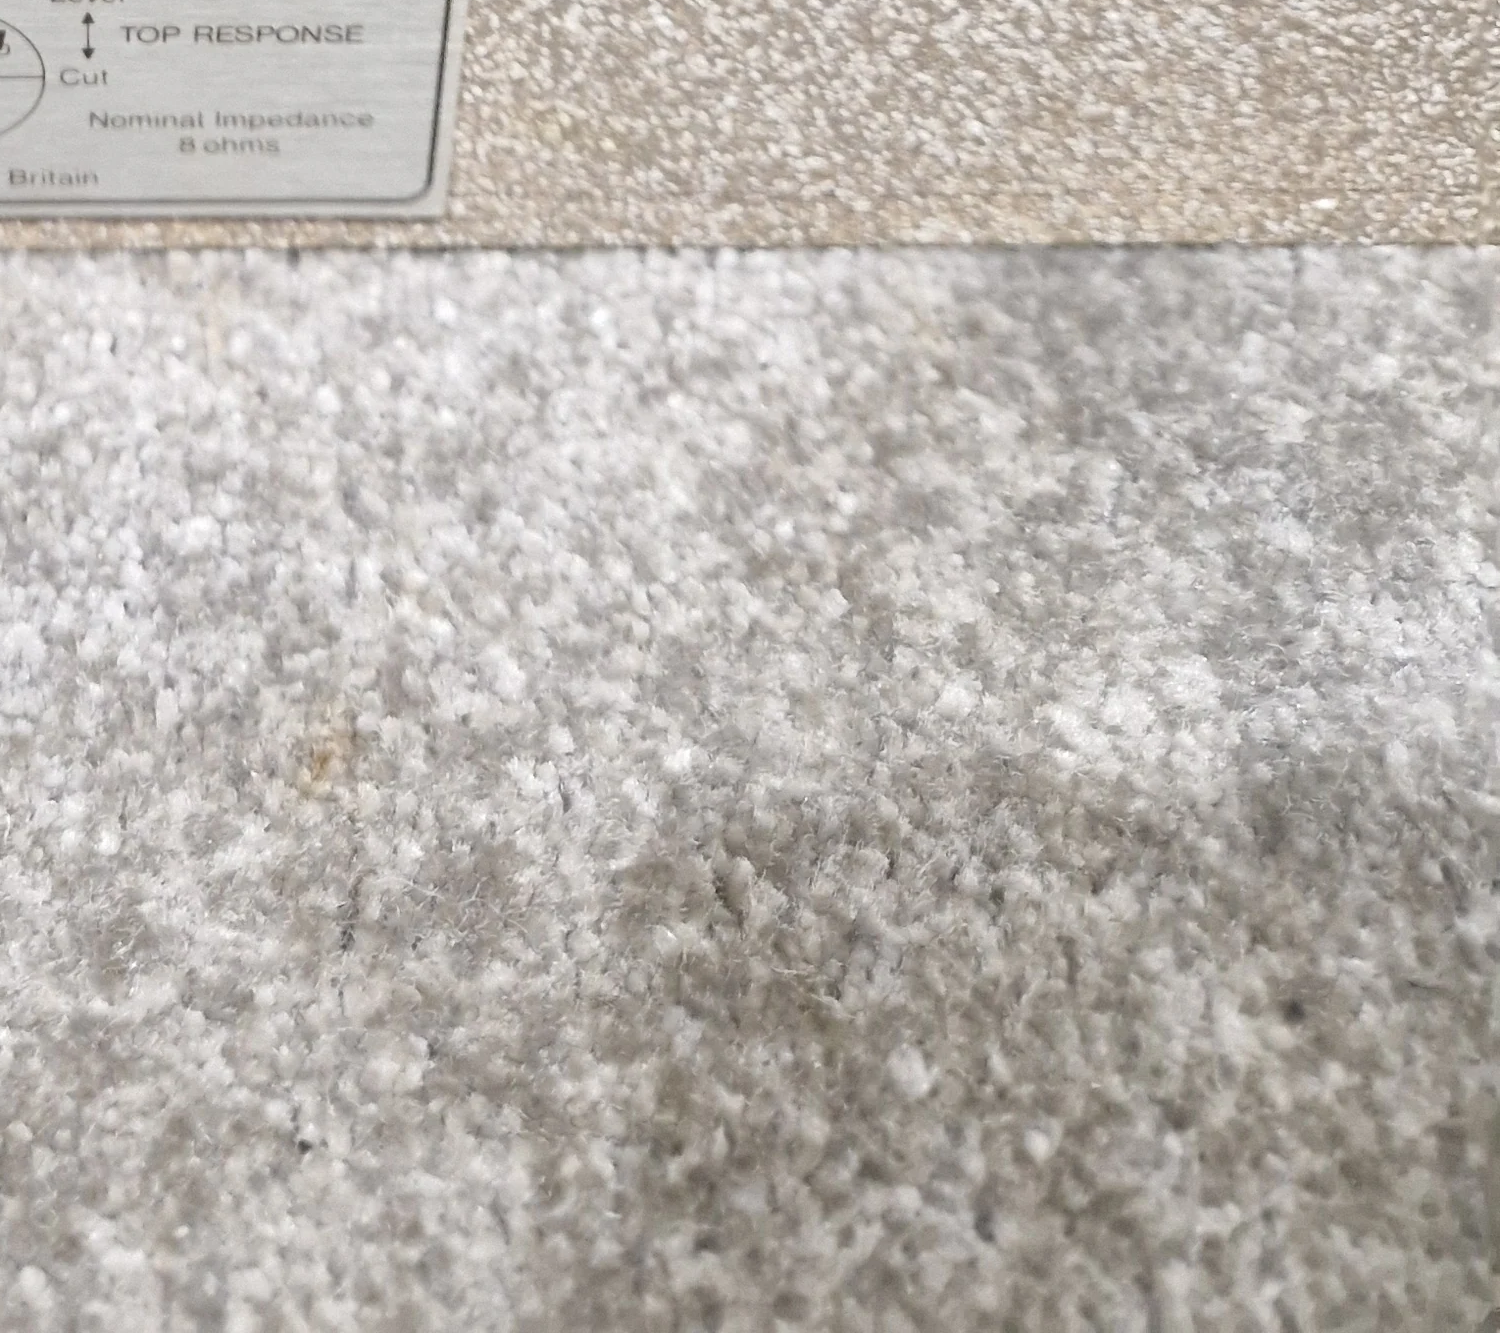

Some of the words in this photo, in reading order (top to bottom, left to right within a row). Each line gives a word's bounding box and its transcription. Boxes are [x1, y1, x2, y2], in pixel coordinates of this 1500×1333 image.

[121, 25, 180, 44] TOP
[193, 25, 365, 44] RESPONSE
[59, 68, 109, 86] Cut
[88, 110, 205, 130] Nominal
[214, 108, 376, 133] Impedance
[203, 136, 281, 154] ohms
[8, 169, 100, 187] Britain
